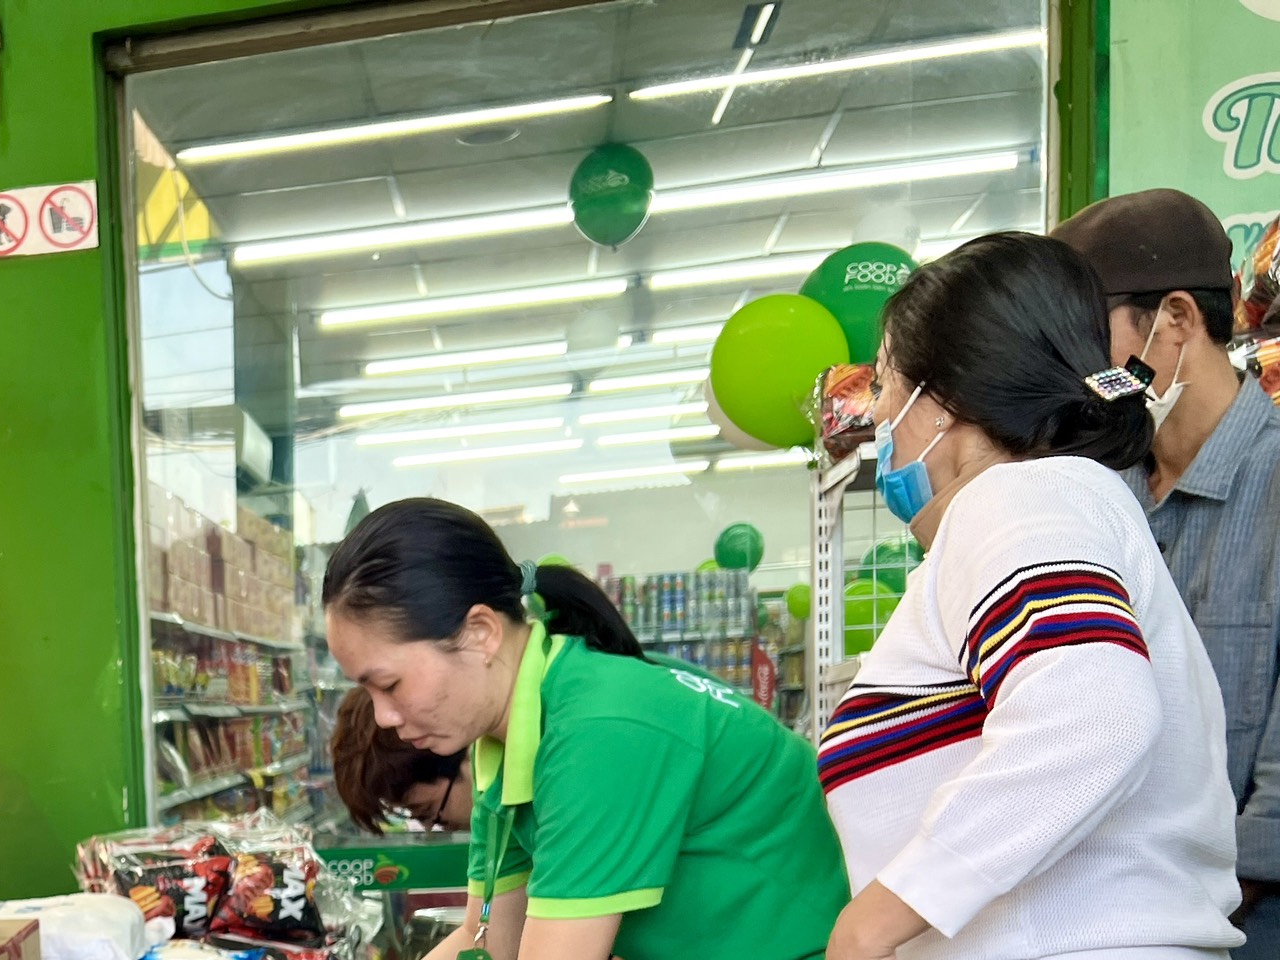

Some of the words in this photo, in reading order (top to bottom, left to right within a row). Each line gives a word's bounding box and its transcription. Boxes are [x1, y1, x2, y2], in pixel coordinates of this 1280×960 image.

[846, 262, 896, 275] COOP
[844, 273, 896, 286] FOOD
[328, 860, 373, 873] COOP
